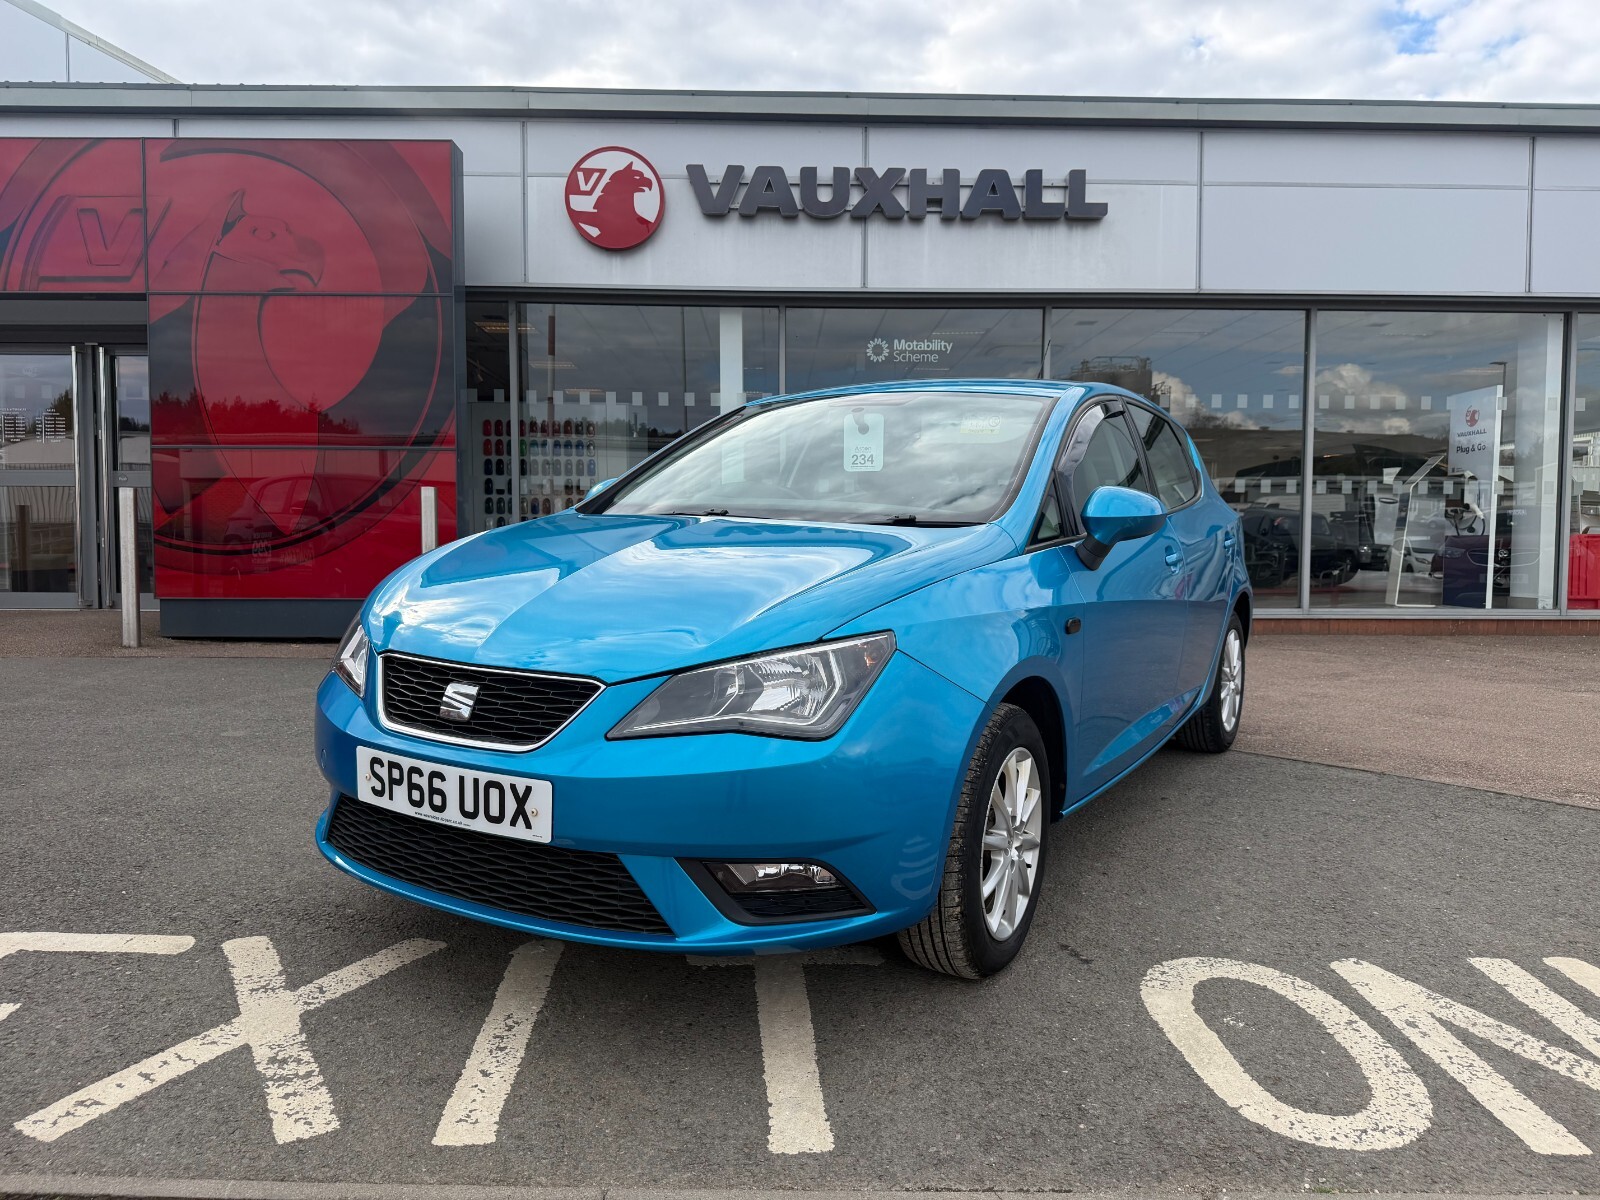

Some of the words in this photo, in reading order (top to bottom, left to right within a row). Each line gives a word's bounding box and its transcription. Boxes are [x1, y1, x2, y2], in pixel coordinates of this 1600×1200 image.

[686, 164, 1109, 220] VAUXHALL
[893, 338, 953, 354] Motability
[893, 351, 939, 363] Scheme
[1457, 428, 1487, 437] VAUXHALL
[1456, 445, 1470, 454] Plug
[1470, 444, 1476, 452] &
[1477, 443, 1487, 451] Go
[851, 454, 875, 465] 234
[369, 756, 447, 814] SP66
[459, 775, 533, 830] UOX
[1139, 956, 1600, 1156] ON
